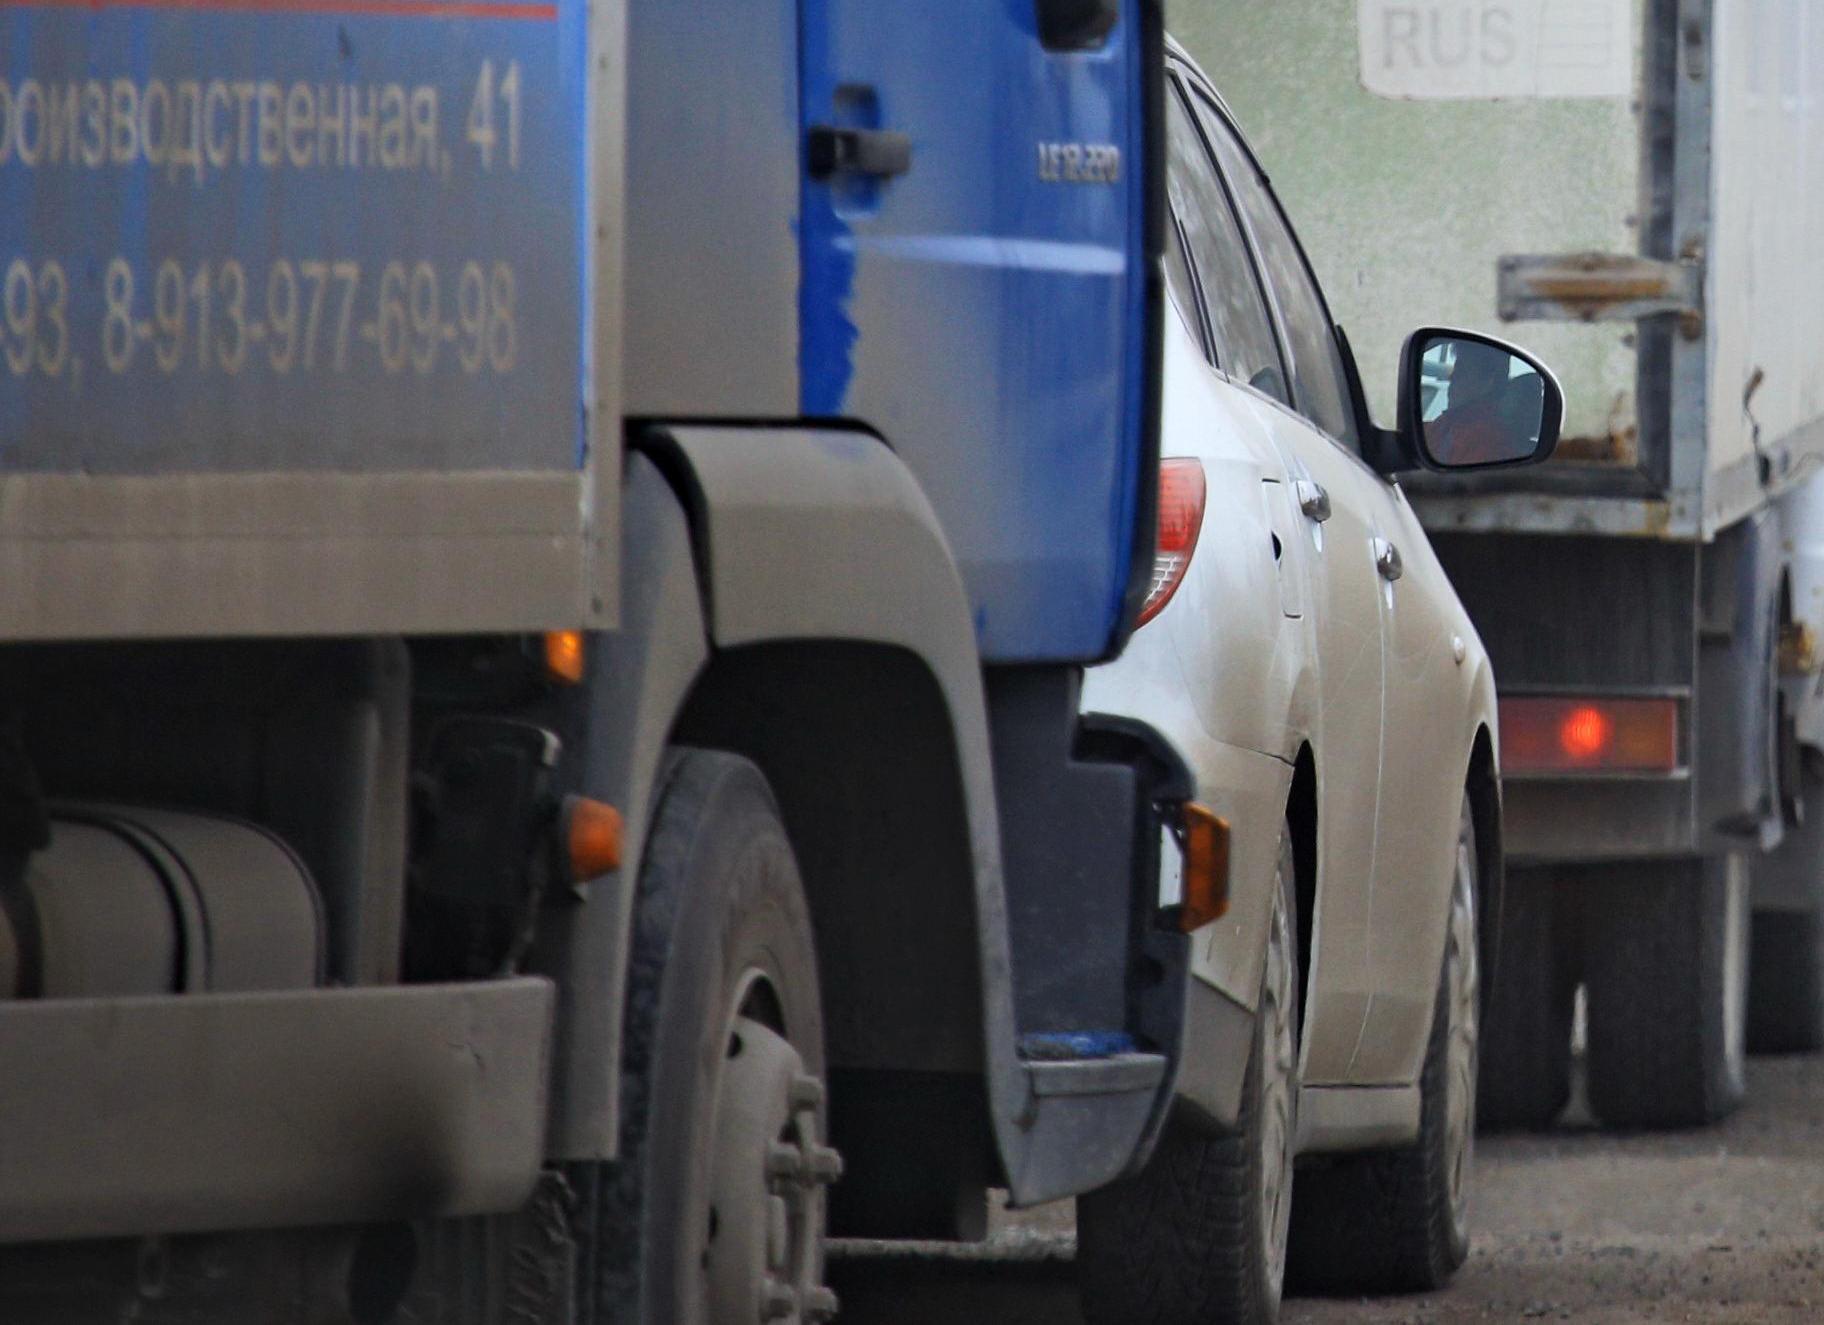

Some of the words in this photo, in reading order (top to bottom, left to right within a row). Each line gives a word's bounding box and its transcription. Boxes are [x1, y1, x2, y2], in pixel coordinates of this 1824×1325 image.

[1383, 8, 1517, 69] RUS
[465, 58, 523, 172] 41
[104, 257, 516, 376] 8-913-977-69-98
